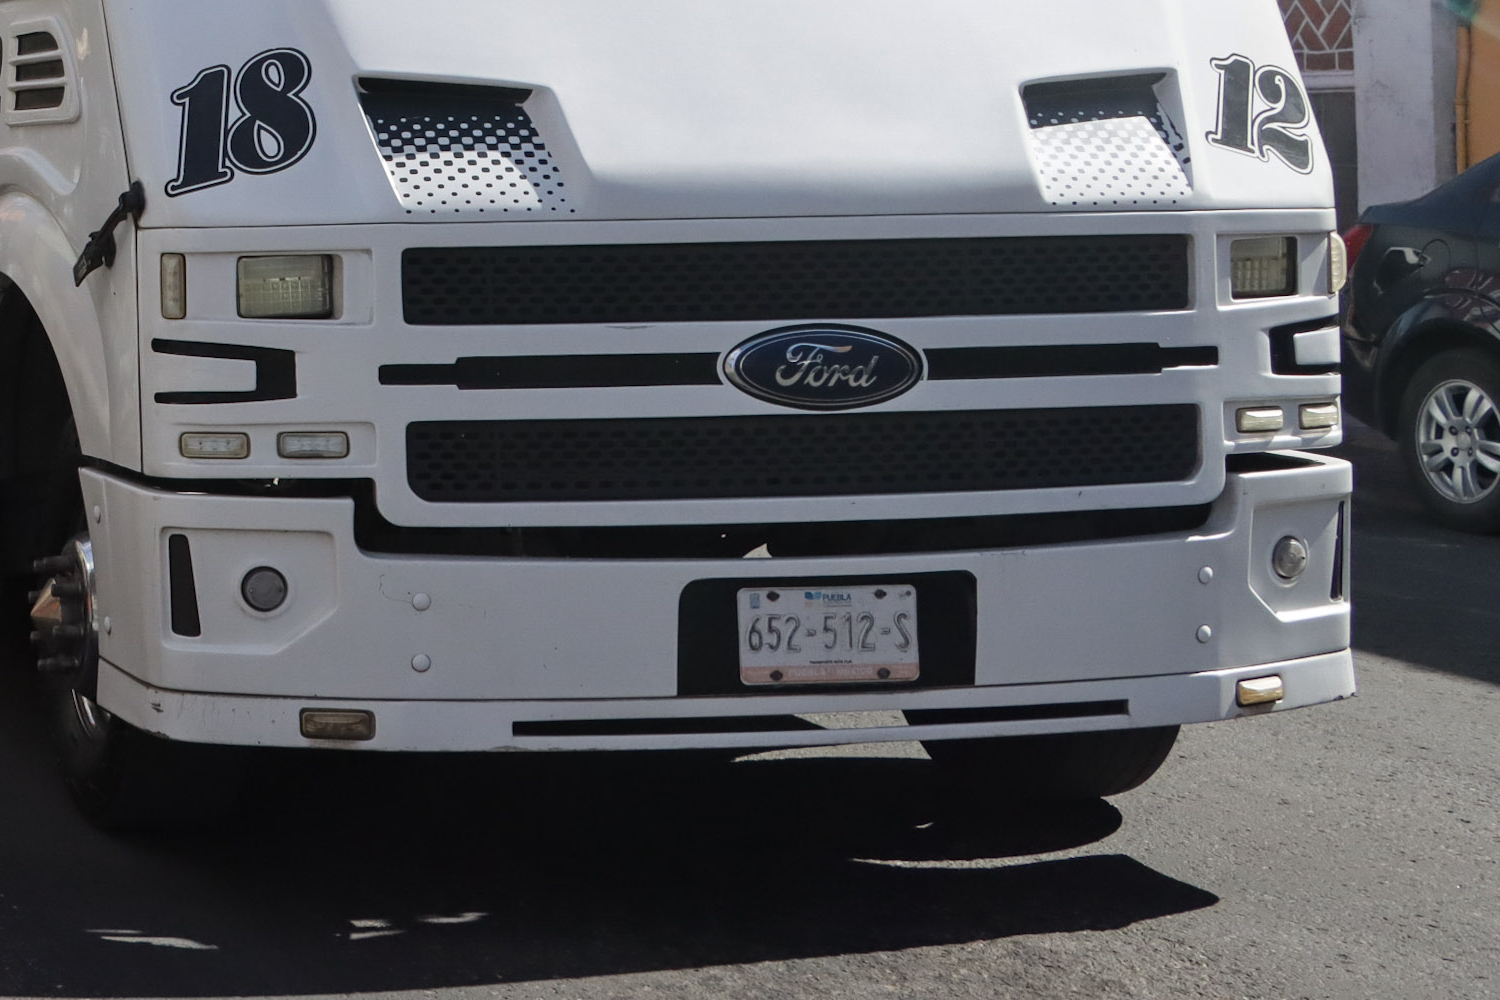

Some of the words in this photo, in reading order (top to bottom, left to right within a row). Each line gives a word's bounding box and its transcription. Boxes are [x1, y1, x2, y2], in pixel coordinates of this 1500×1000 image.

[165, 47, 317, 198] 18
[1205, 53, 1314, 175] 12
[775, 342, 879, 388] Ford
[748, 611, 912, 653] 652-512-S
